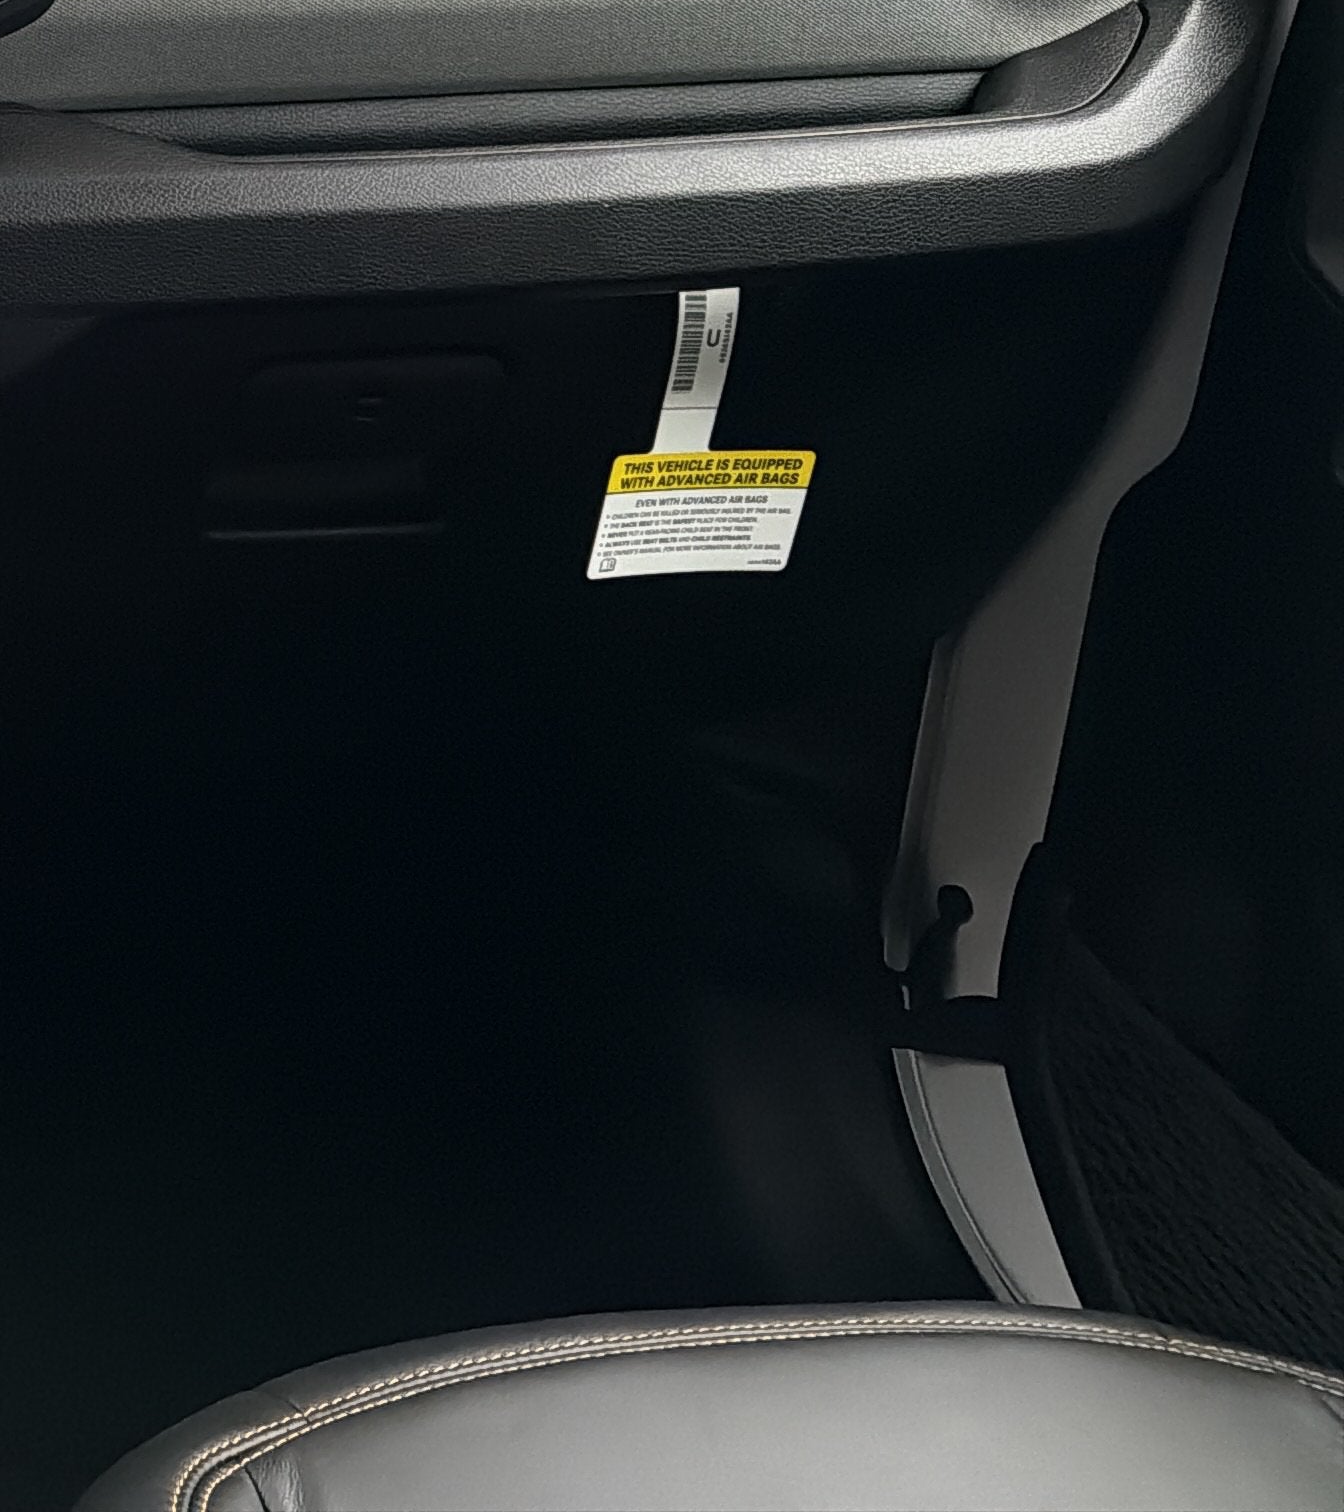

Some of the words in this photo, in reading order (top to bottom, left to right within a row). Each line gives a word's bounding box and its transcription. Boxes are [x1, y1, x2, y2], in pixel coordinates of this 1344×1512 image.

[706, 328, 722, 349] U
[623, 461, 654, 475] THIS
[657, 459, 714, 473] VEHICLE
[715, 458, 730, 471] IS
[732, 458, 803, 471] EQUIPPED
[620, 476, 655, 489] WITH
[657, 473, 732, 487] ADVANCED
[734, 472, 758, 485] AIR
[760, 472, 800, 485] BAGS
[635, 497, 657, 508] EVEN
[659, 496, 680, 507] WITH
[681, 495, 727, 506] ADVANCED
[729, 494, 743, 505] AIR
[745, 494, 768, 505] BAGS
